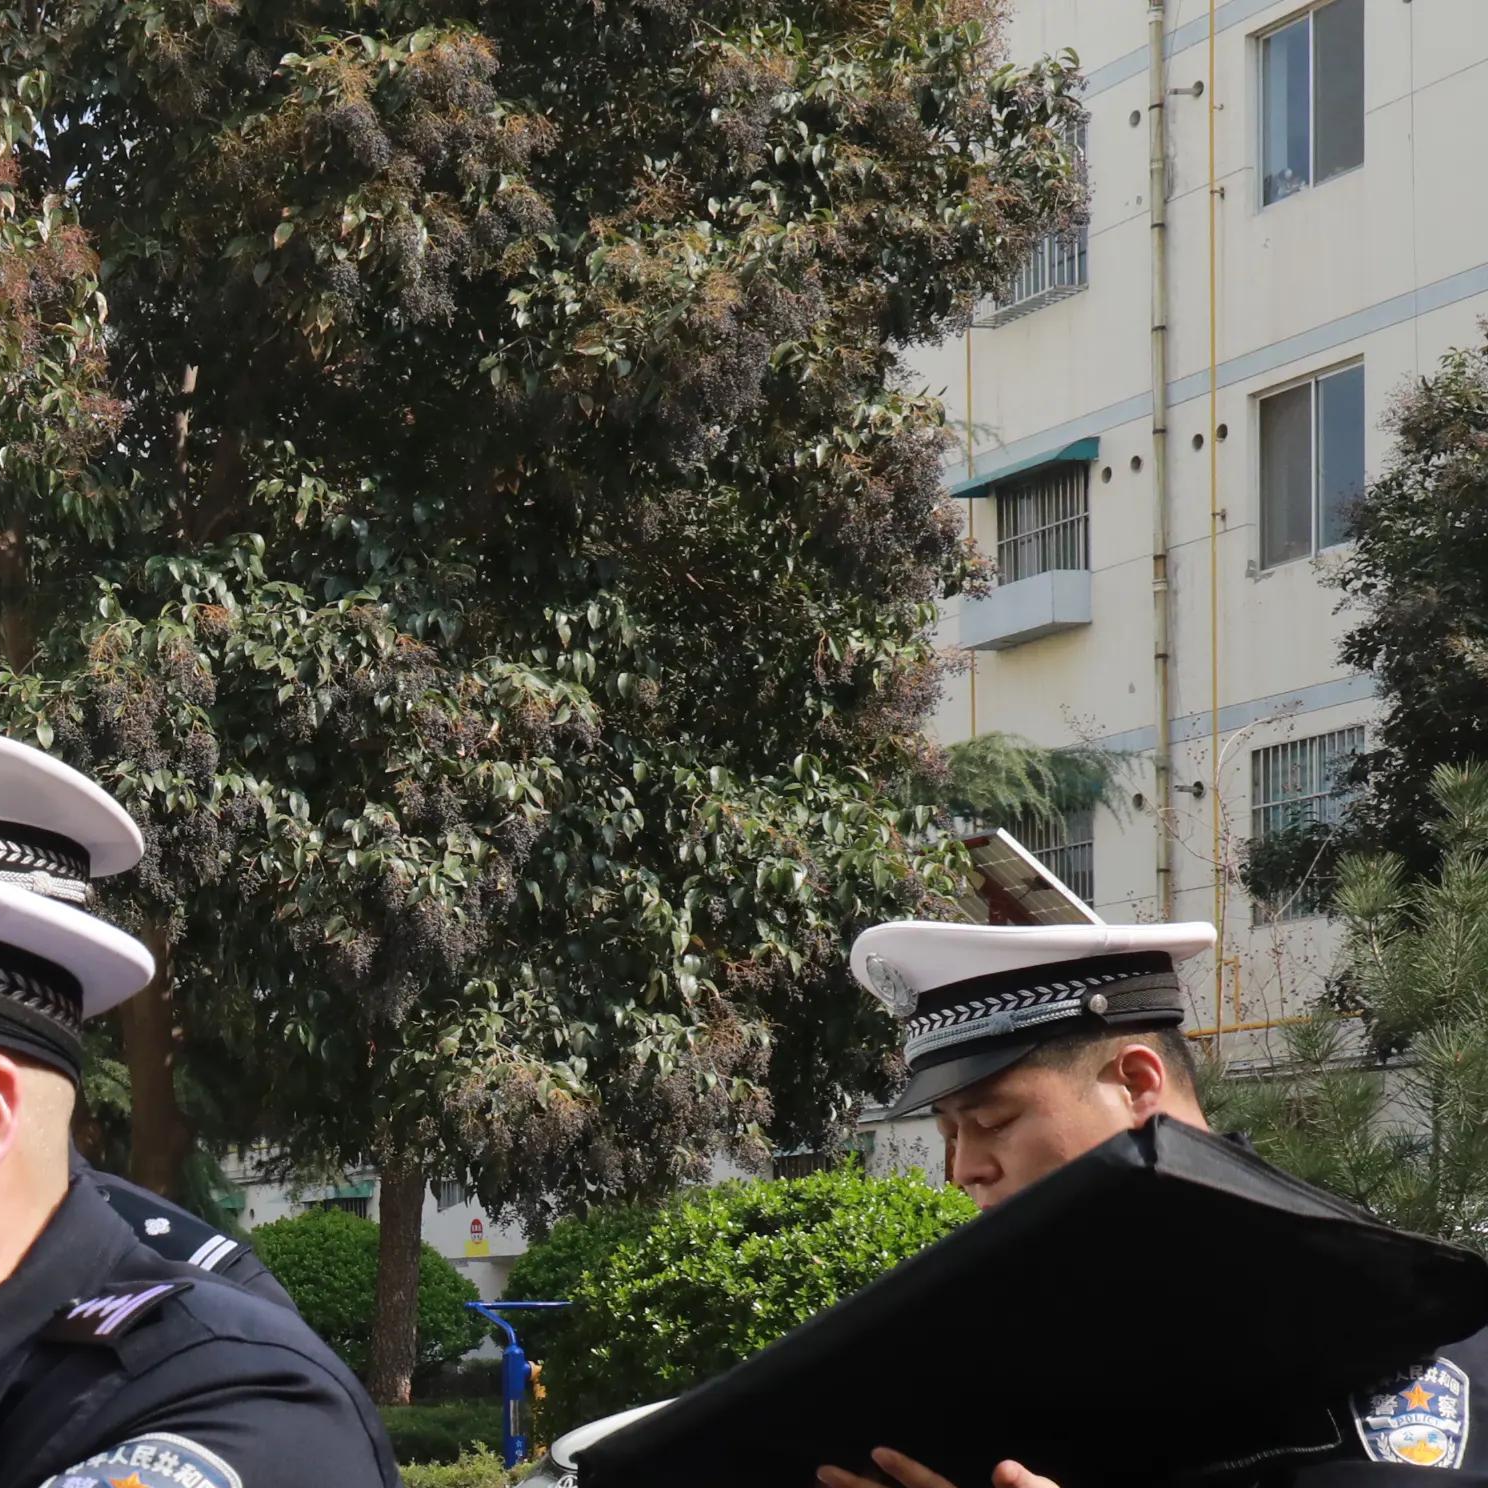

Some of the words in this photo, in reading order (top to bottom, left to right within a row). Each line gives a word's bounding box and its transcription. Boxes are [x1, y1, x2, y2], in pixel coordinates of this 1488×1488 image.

[1366, 1363, 1462, 1397] 人民共和国
[1369, 1394, 1399, 1417] 警
[1437, 1394, 1460, 1419] 察
